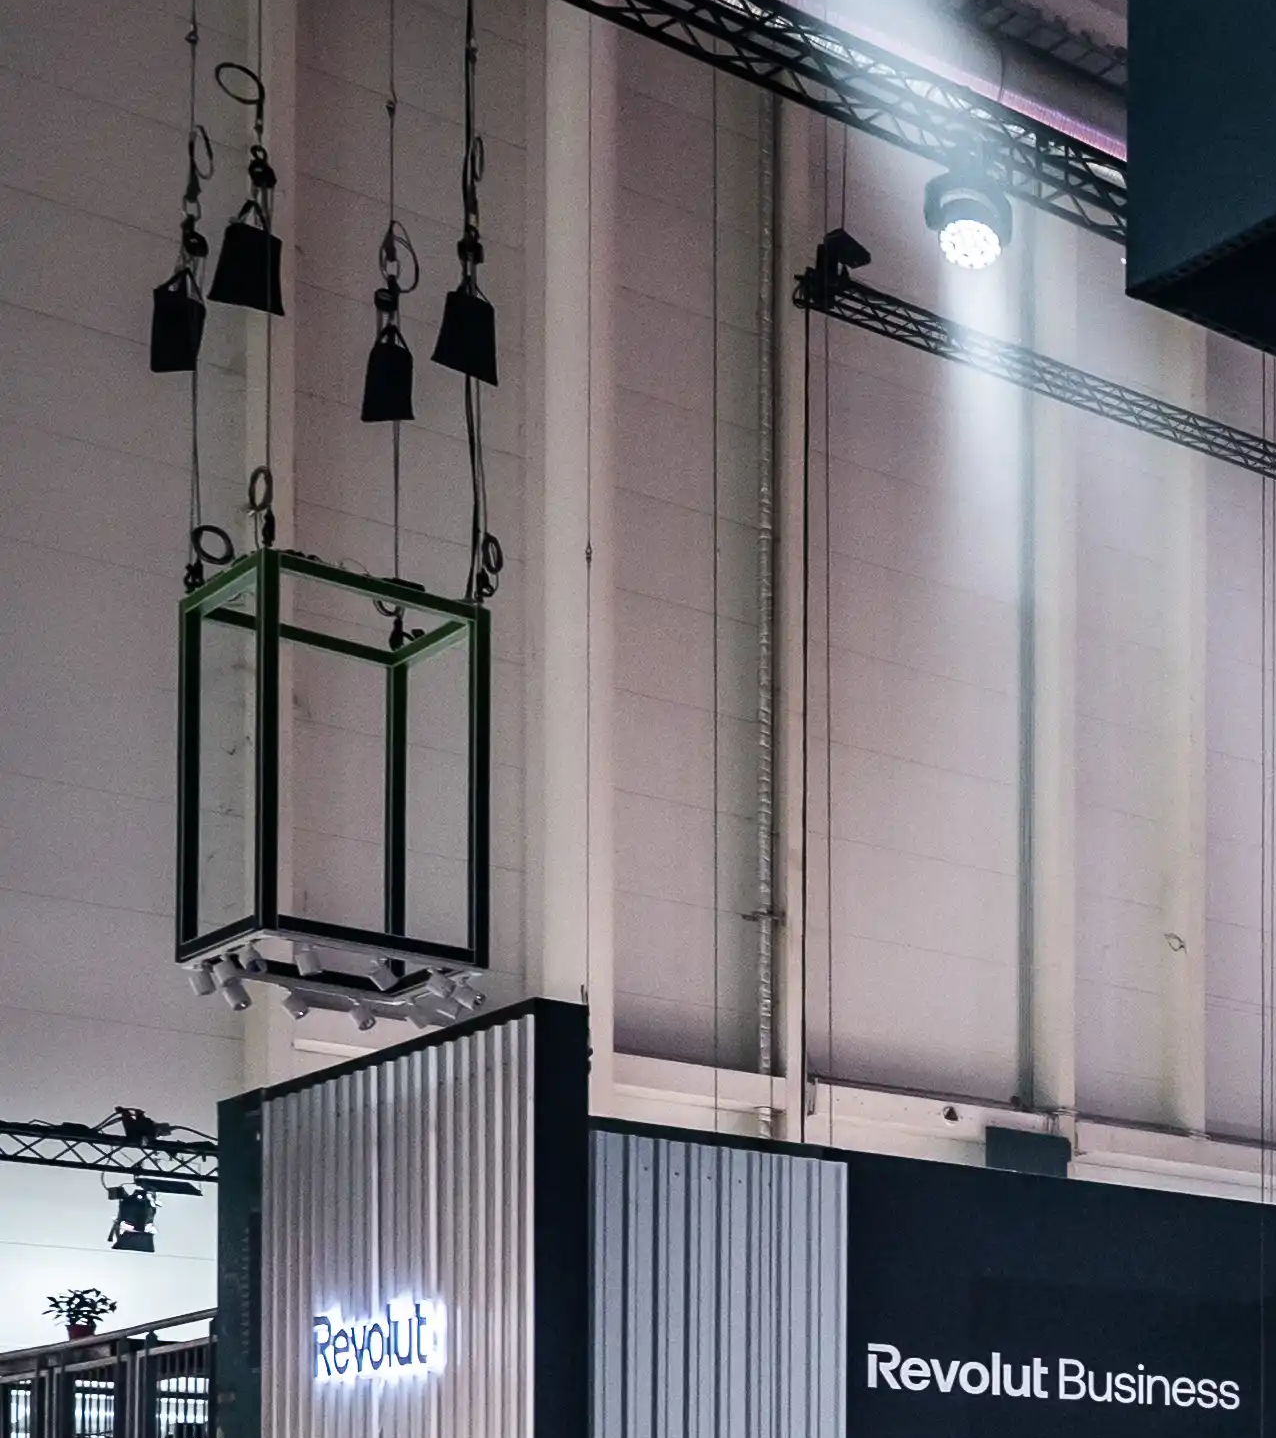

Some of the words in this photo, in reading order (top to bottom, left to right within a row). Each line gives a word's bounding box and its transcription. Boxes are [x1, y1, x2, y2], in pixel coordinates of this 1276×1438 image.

[313, 1301, 428, 1379] Revolut
[867, 1342, 1049, 1399] Revolut
[1058, 1357, 1241, 1410] Business
